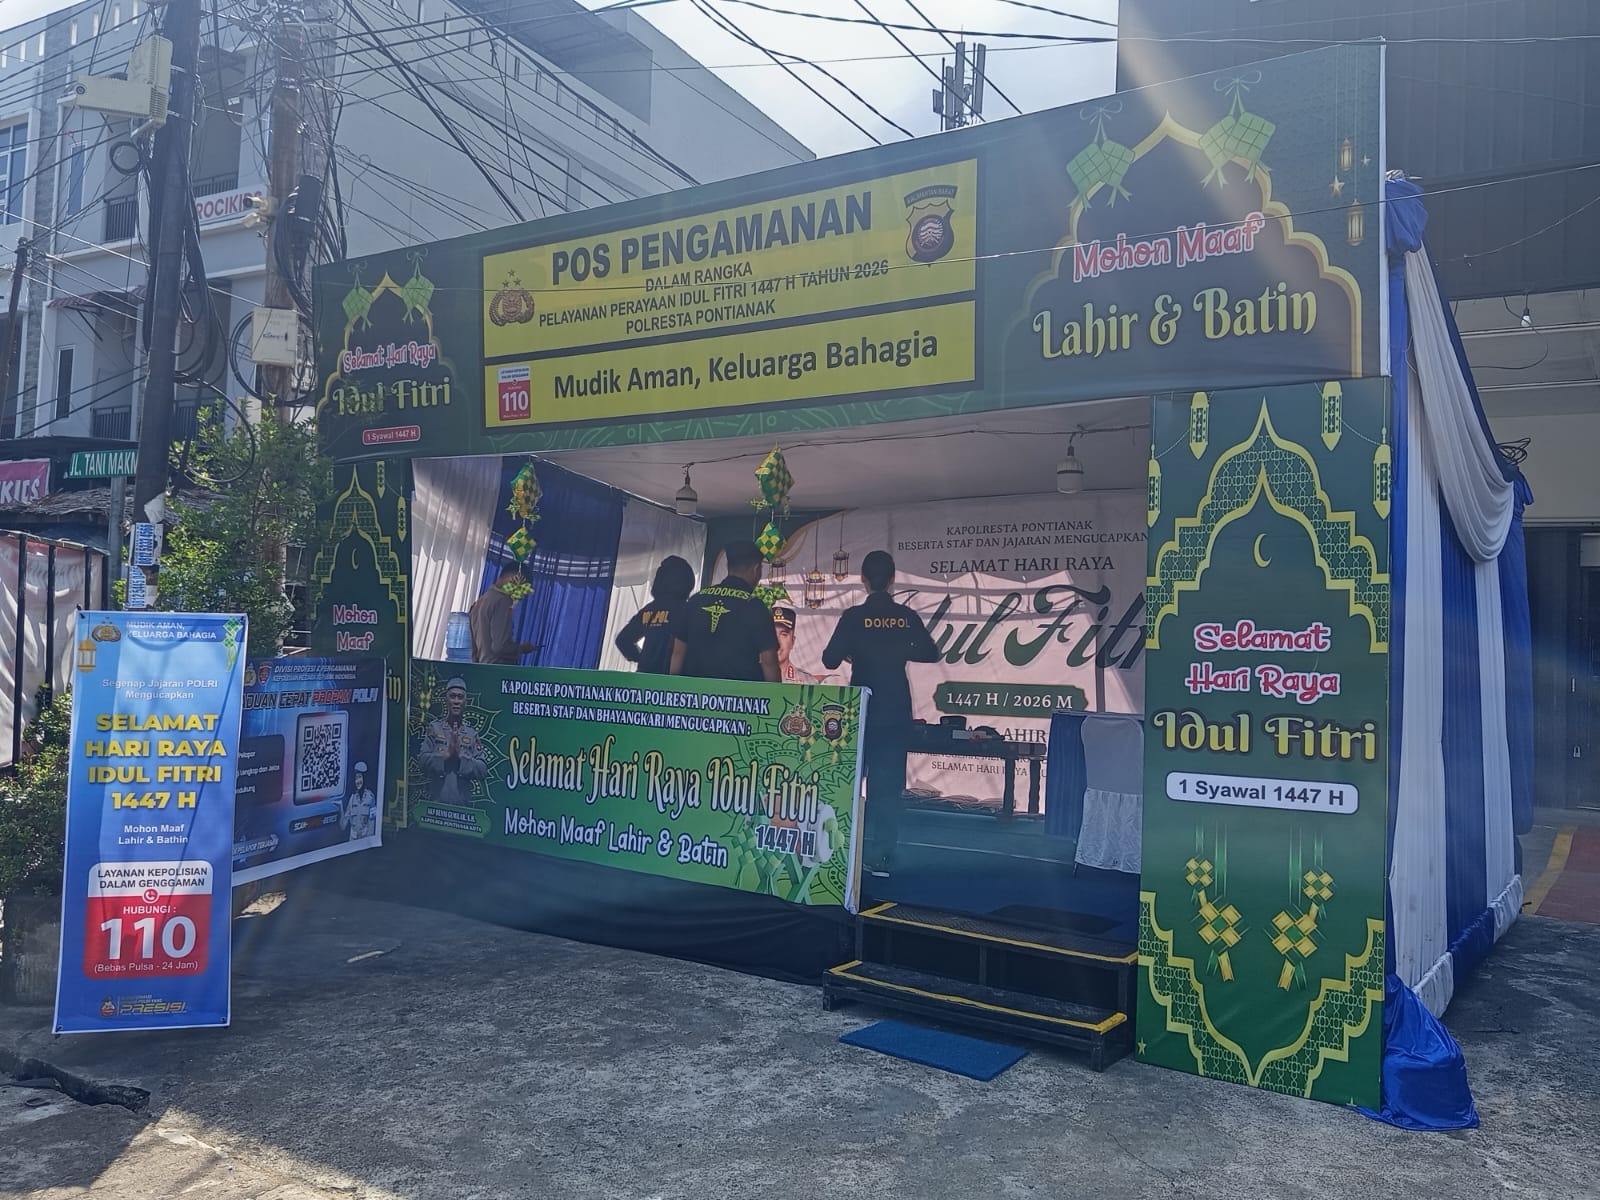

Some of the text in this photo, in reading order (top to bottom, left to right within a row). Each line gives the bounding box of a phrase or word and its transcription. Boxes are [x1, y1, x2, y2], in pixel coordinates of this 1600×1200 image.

[552, 192, 872, 286] POS PENGAMANAN
[1073, 211, 1265, 283] Mohon Maaf
[645, 262, 752, 292] DALAM RANGKA
[539, 259, 889, 327] PELAYANAN PERAYAAN IDUL FITRI 1447 H TAHUN 2026
[626, 299, 775, 334] POLRESTA PONTIANAK
[1033, 281, 1317, 359] Lahir & Batin
[343, 341, 435, 373] Selamat Hari Raya
[554, 330, 938, 399] Mudik Aman, Keluarga Bahagia
[333, 377, 450, 415] Idul Fitri
[502, 391, 529, 411] 110
[371, 431, 394, 441] Syawal
[70, 453, 82, 476] JL.
[85, 452, 106, 475] TANI
[946, 520, 1093, 536] KAPOLRESTA PONTIANAK
[898, 540, 944, 551] BESERTA
[946, 538, 973, 549] STAF
[975, 537, 999, 548] DAN
[1000, 536, 1052, 549] JAJARAN
[930, 556, 1115, 574] SELAMAT HARI RAYA
[333, 604, 377, 625] Mohon
[864, 617, 911, 628] DOKPOL
[128, 630, 216, 639] KELUARGA BAHAGIA
[336, 631, 374, 652] Maaf
[1194, 620, 1331, 652] Selamat
[102, 679, 218, 689] Segenap Jajaran POLRI
[1185, 661, 1341, 705] Hari Raya
[125, 690, 194, 700] Mengucapkan
[279, 690, 312, 708] CEPAT
[501, 680, 769, 715] KAPOLSEK PONTIANAK KOTA POLRESTA PONTIANAK
[946, 693, 1073, 709] 1447 H / 2026 M
[96, 714, 219, 731] SELAMAT
[513, 702, 550, 717] BESERTA
[552, 704, 575, 719] STAF
[576, 707, 595, 721] DAN
[596, 708, 665, 728] BHAYANGKARI
[666, 715, 745, 735] MENGUCAPKAN
[1003, 728, 1046, 743] AHIR
[1153, 711, 1376, 760] Idul Fitri
[85, 740, 227, 757] HARI RAYA
[88, 766, 150, 783] IDUL
[157, 765, 222, 783] FITRI
[932, 761, 974, 773] SELAMAT
[976, 764, 1000, 774] HARI
[506, 734, 820, 824] Selamat Hari Raya Idul Fitri
[112, 791, 196, 809] 1447 H
[1179, 780, 1344, 806] 1 Syawal 1447 H
[124, 824, 185, 833] Mohon Maaf
[504, 807, 556, 839] Mohon
[560, 814, 606, 845] Maaf
[608, 822, 652, 854] Lahir
[656, 828, 673, 857] &
[677, 833, 728, 868] Batin
[118, 835, 188, 845] Lahir & Bathin
[755, 824, 817, 858] 1447 H
[98, 867, 208, 878] LAYANAN KEPOLISIAN
[99, 878, 205, 889] DALAM GENGGAMAN
[123, 905, 171, 914] HUBUNGI
[100, 915, 197, 960] 110
[94, 963, 126, 974] (Bebas
[128, 962, 154, 971] Pulsa
[162, 961, 173, 970] 24
[175, 961, 199, 970] Jam)
[120, 1002, 186, 1014] PRESISI
